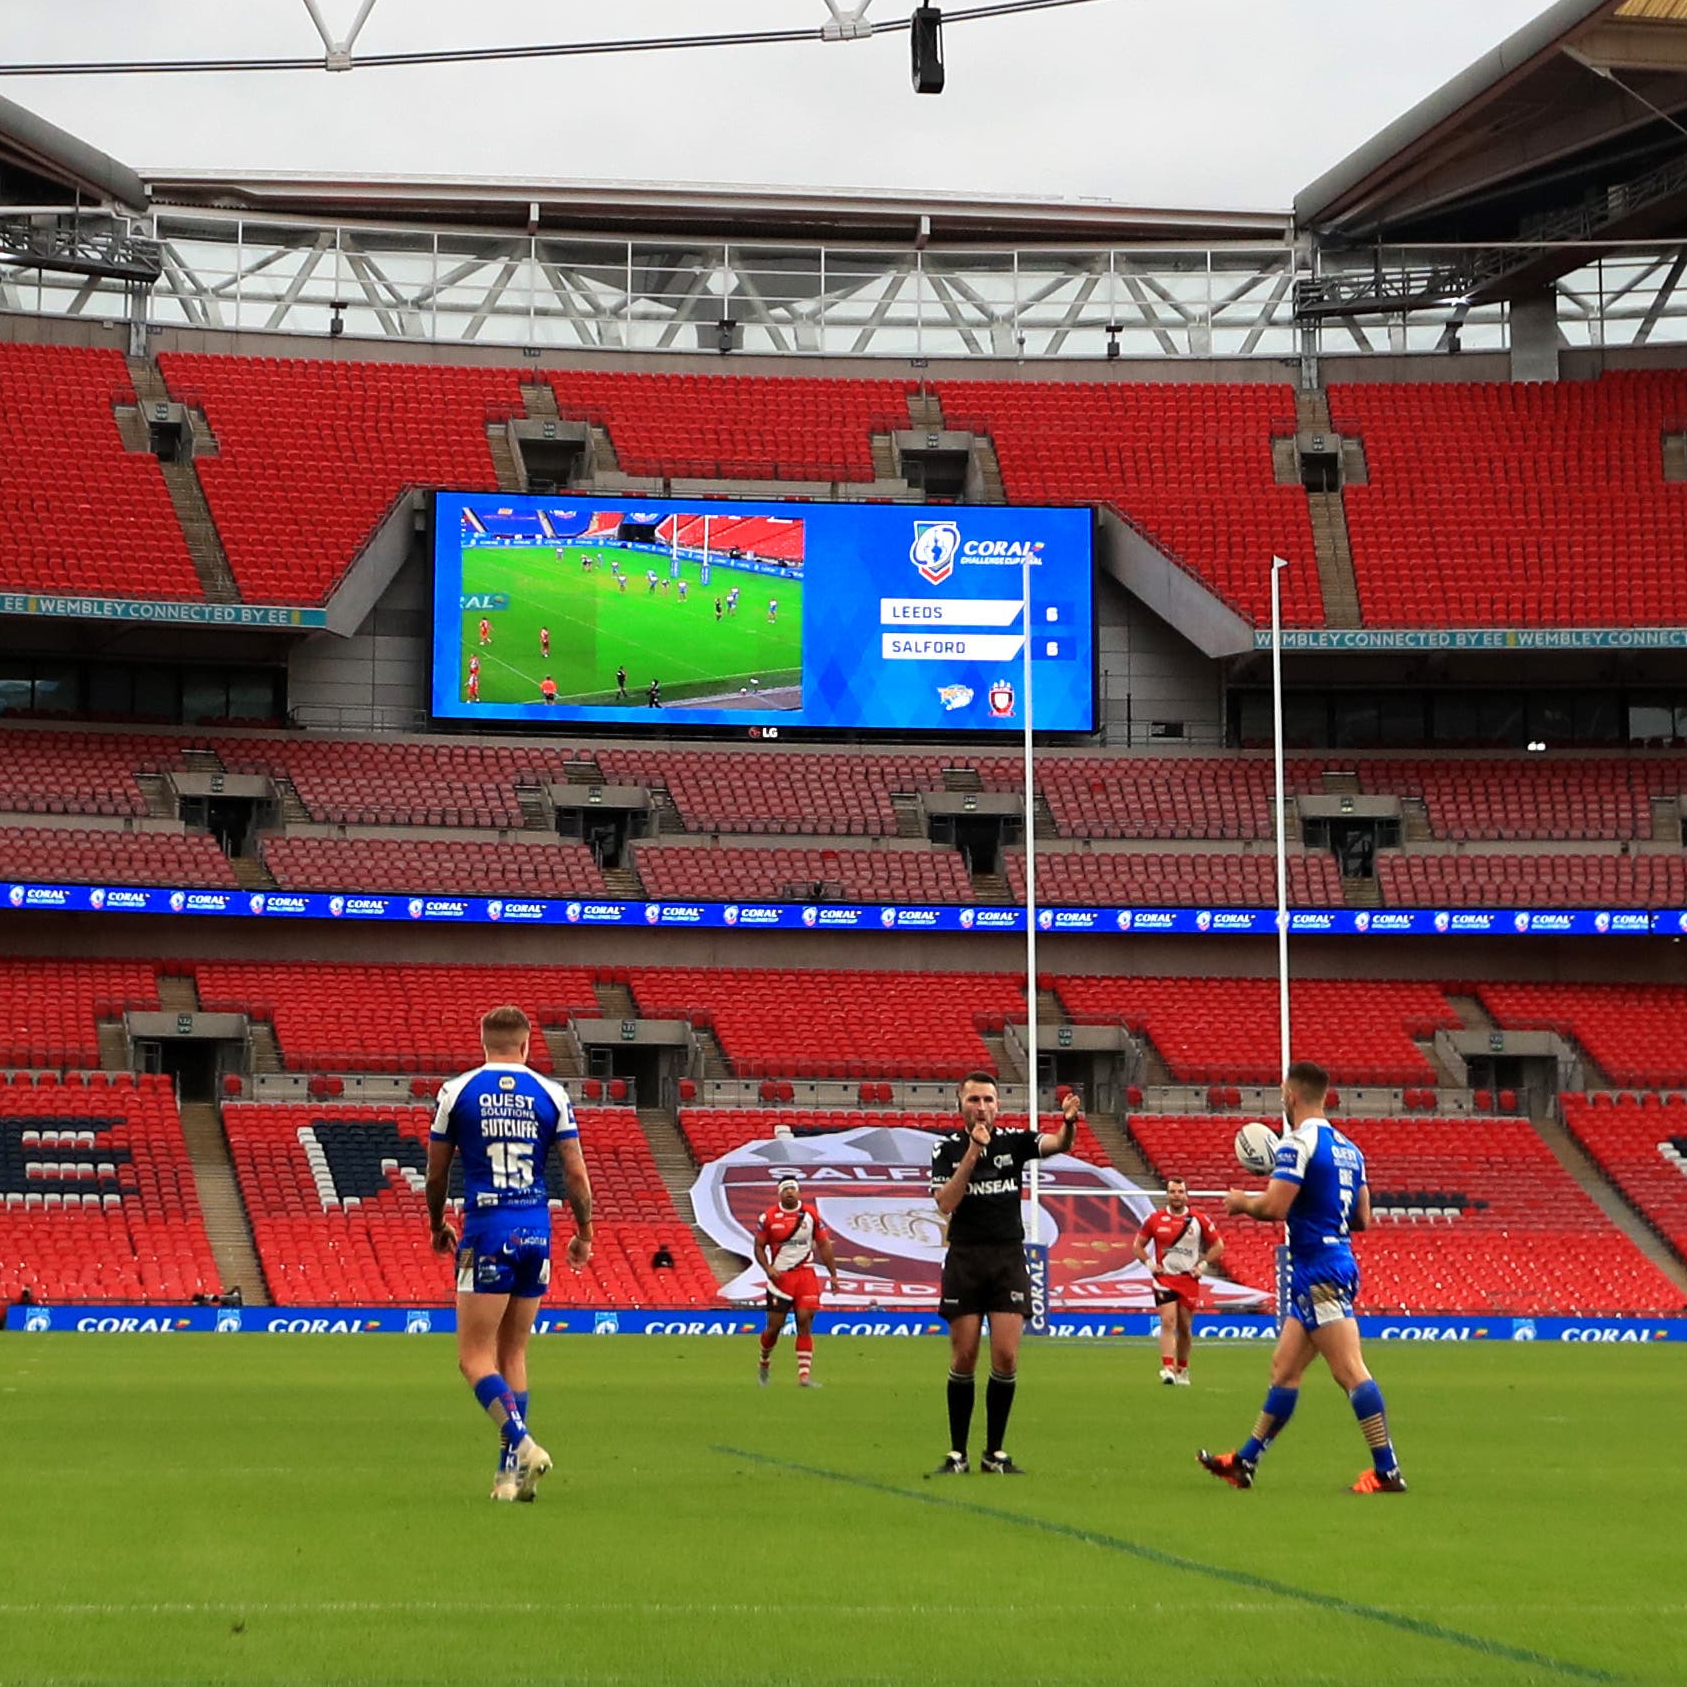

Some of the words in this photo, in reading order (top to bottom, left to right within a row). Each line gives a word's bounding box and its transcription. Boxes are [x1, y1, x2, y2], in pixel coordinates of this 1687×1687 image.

[963, 540, 1032, 556] CORAL
[4, 596, 24, 612] EE
[39, 597, 125, 617] WEMBLEY
[129, 604, 235, 621] CONNECTED
[241, 608, 264, 623] BY
[268, 609, 288, 624] EE
[892, 605, 943, 619] LEEDS
[1255, 632, 1340, 647] WMBLEY
[1344, 632, 1451, 647] CONNECTED
[1455, 632, 1478, 647] BY
[1482, 632, 1503, 646] EE
[1517, 630, 1603, 646] WEMBLEY
[891, 640, 966, 654] SALFORD
[762, 727, 779, 738] LG
[479, 1093, 535, 1111] QUEST
[481, 1107, 536, 1120] SOLUTIONS
[481, 1118, 540, 1139] SUTCLIFFE
[486, 1142, 535, 1190] 15
[1031, 1259, 1045, 1331] CORAL
[76, 1317, 177, 1333] CORAL
[267, 1318, 366, 1334] CORAL
[644, 1321, 738, 1335] CORAL
[830, 1323, 923, 1336] CORAL
[1200, 1325, 1276, 1338] CORA
[1380, 1326, 1471, 1340] CORAL
[1561, 1327, 1653, 1342] CORAL
